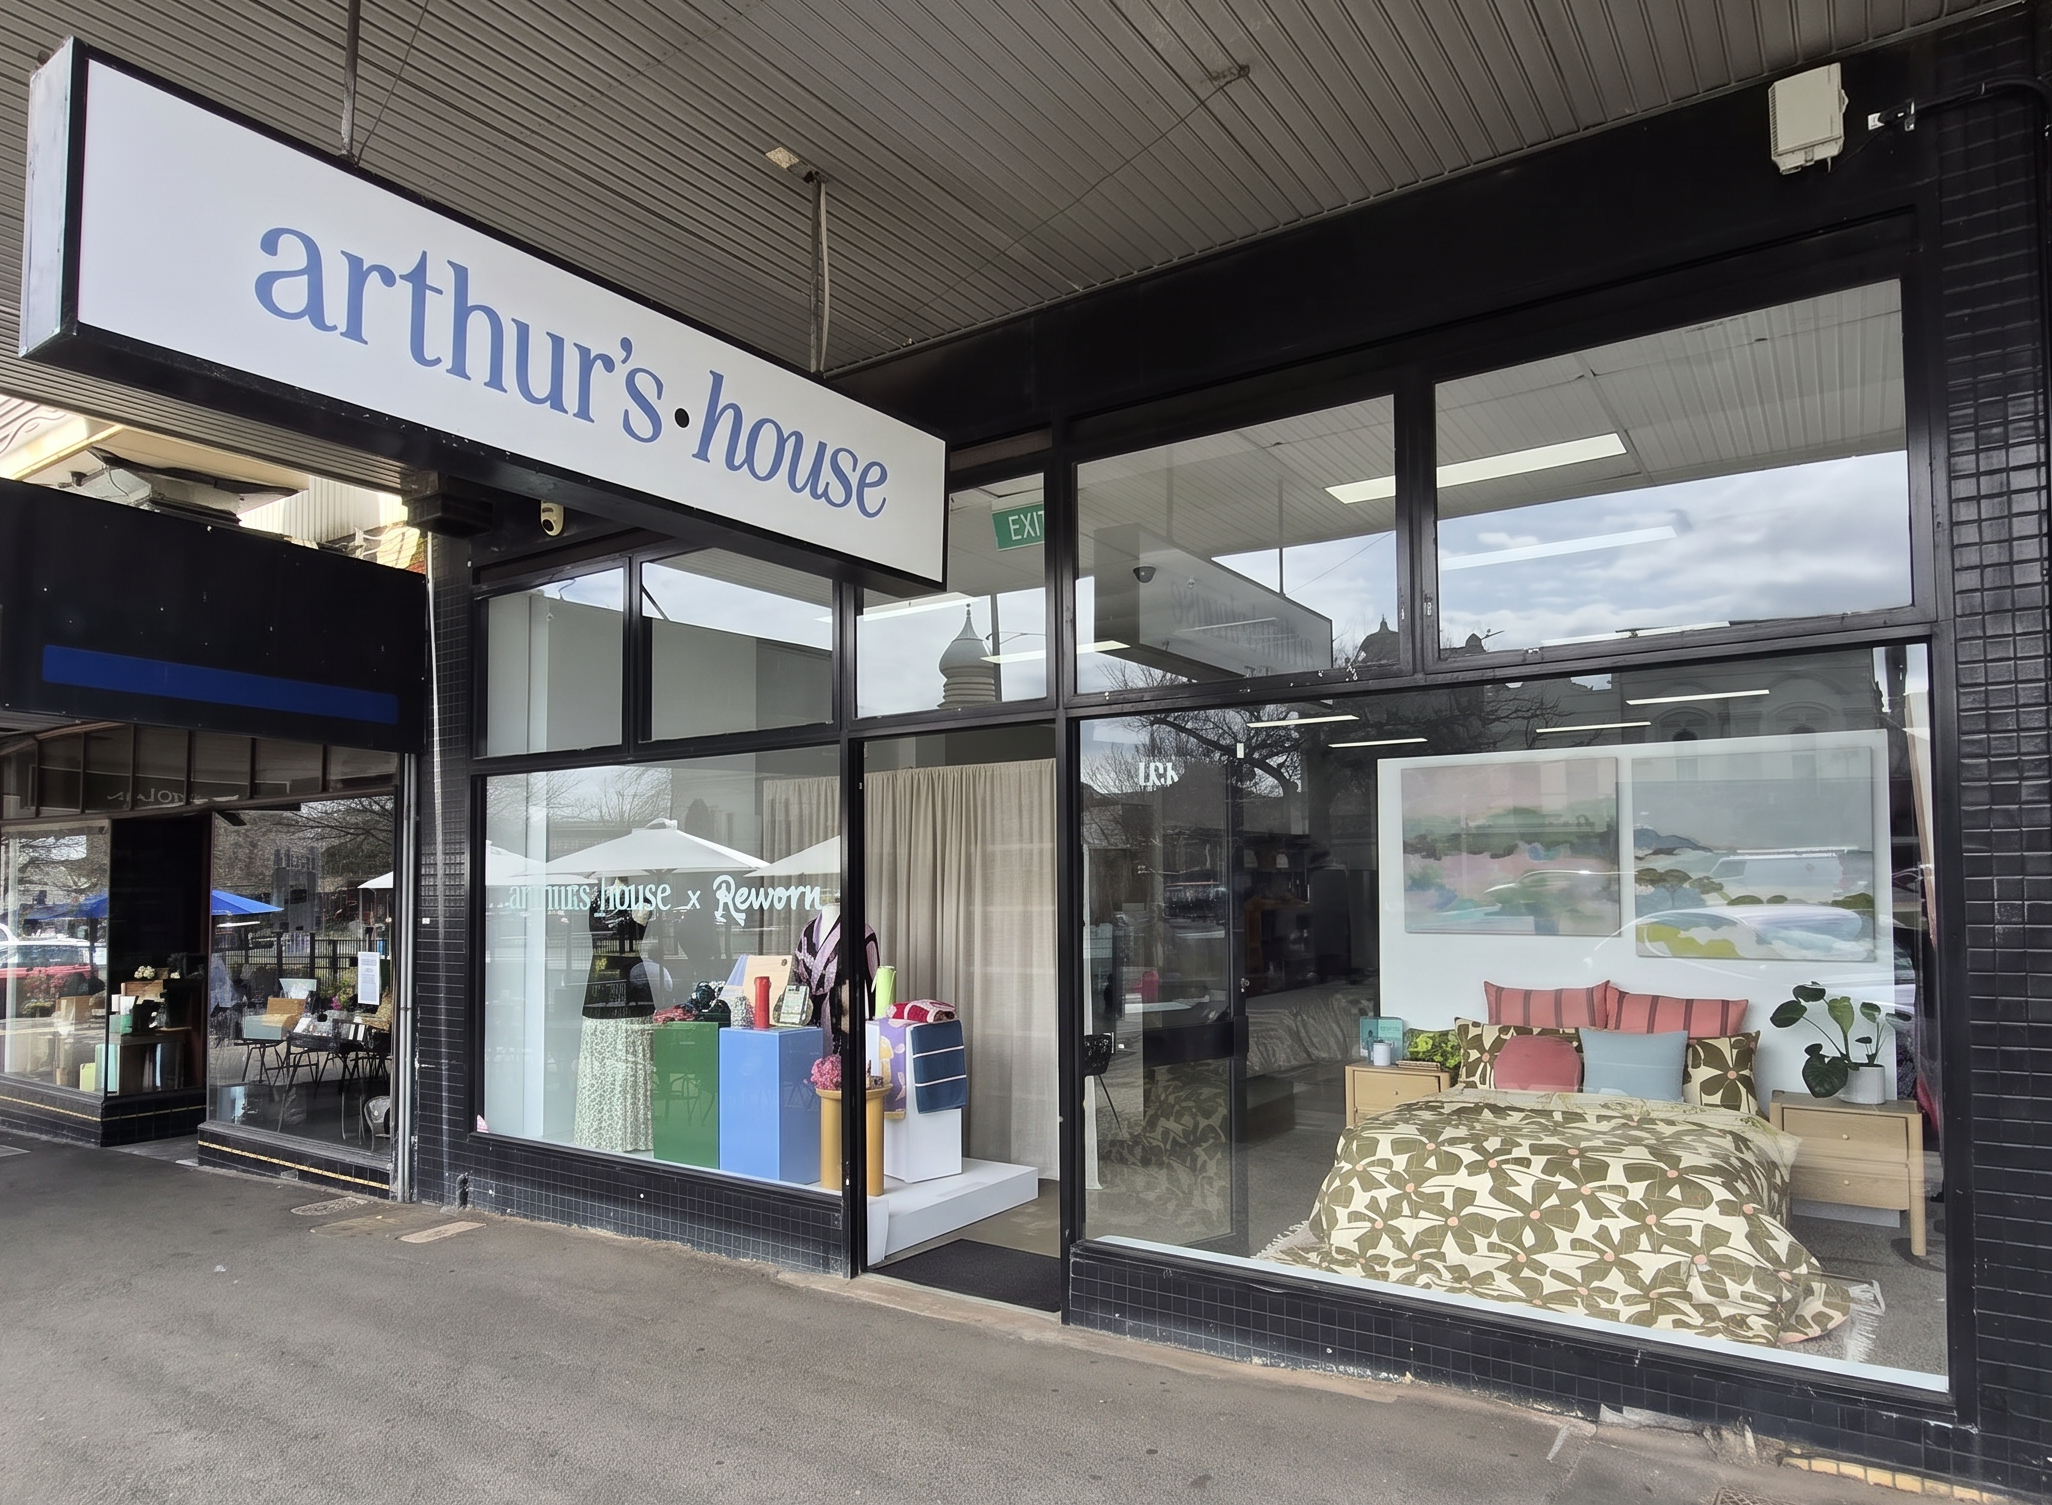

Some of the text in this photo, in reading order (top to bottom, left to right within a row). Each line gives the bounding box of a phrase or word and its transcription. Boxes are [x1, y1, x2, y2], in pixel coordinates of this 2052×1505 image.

[254, 227, 889, 519] arthur's house
[599, 877, 672, 911] house
[686, 890, 701, 909] x
[713, 875, 823, 926] Reworn
